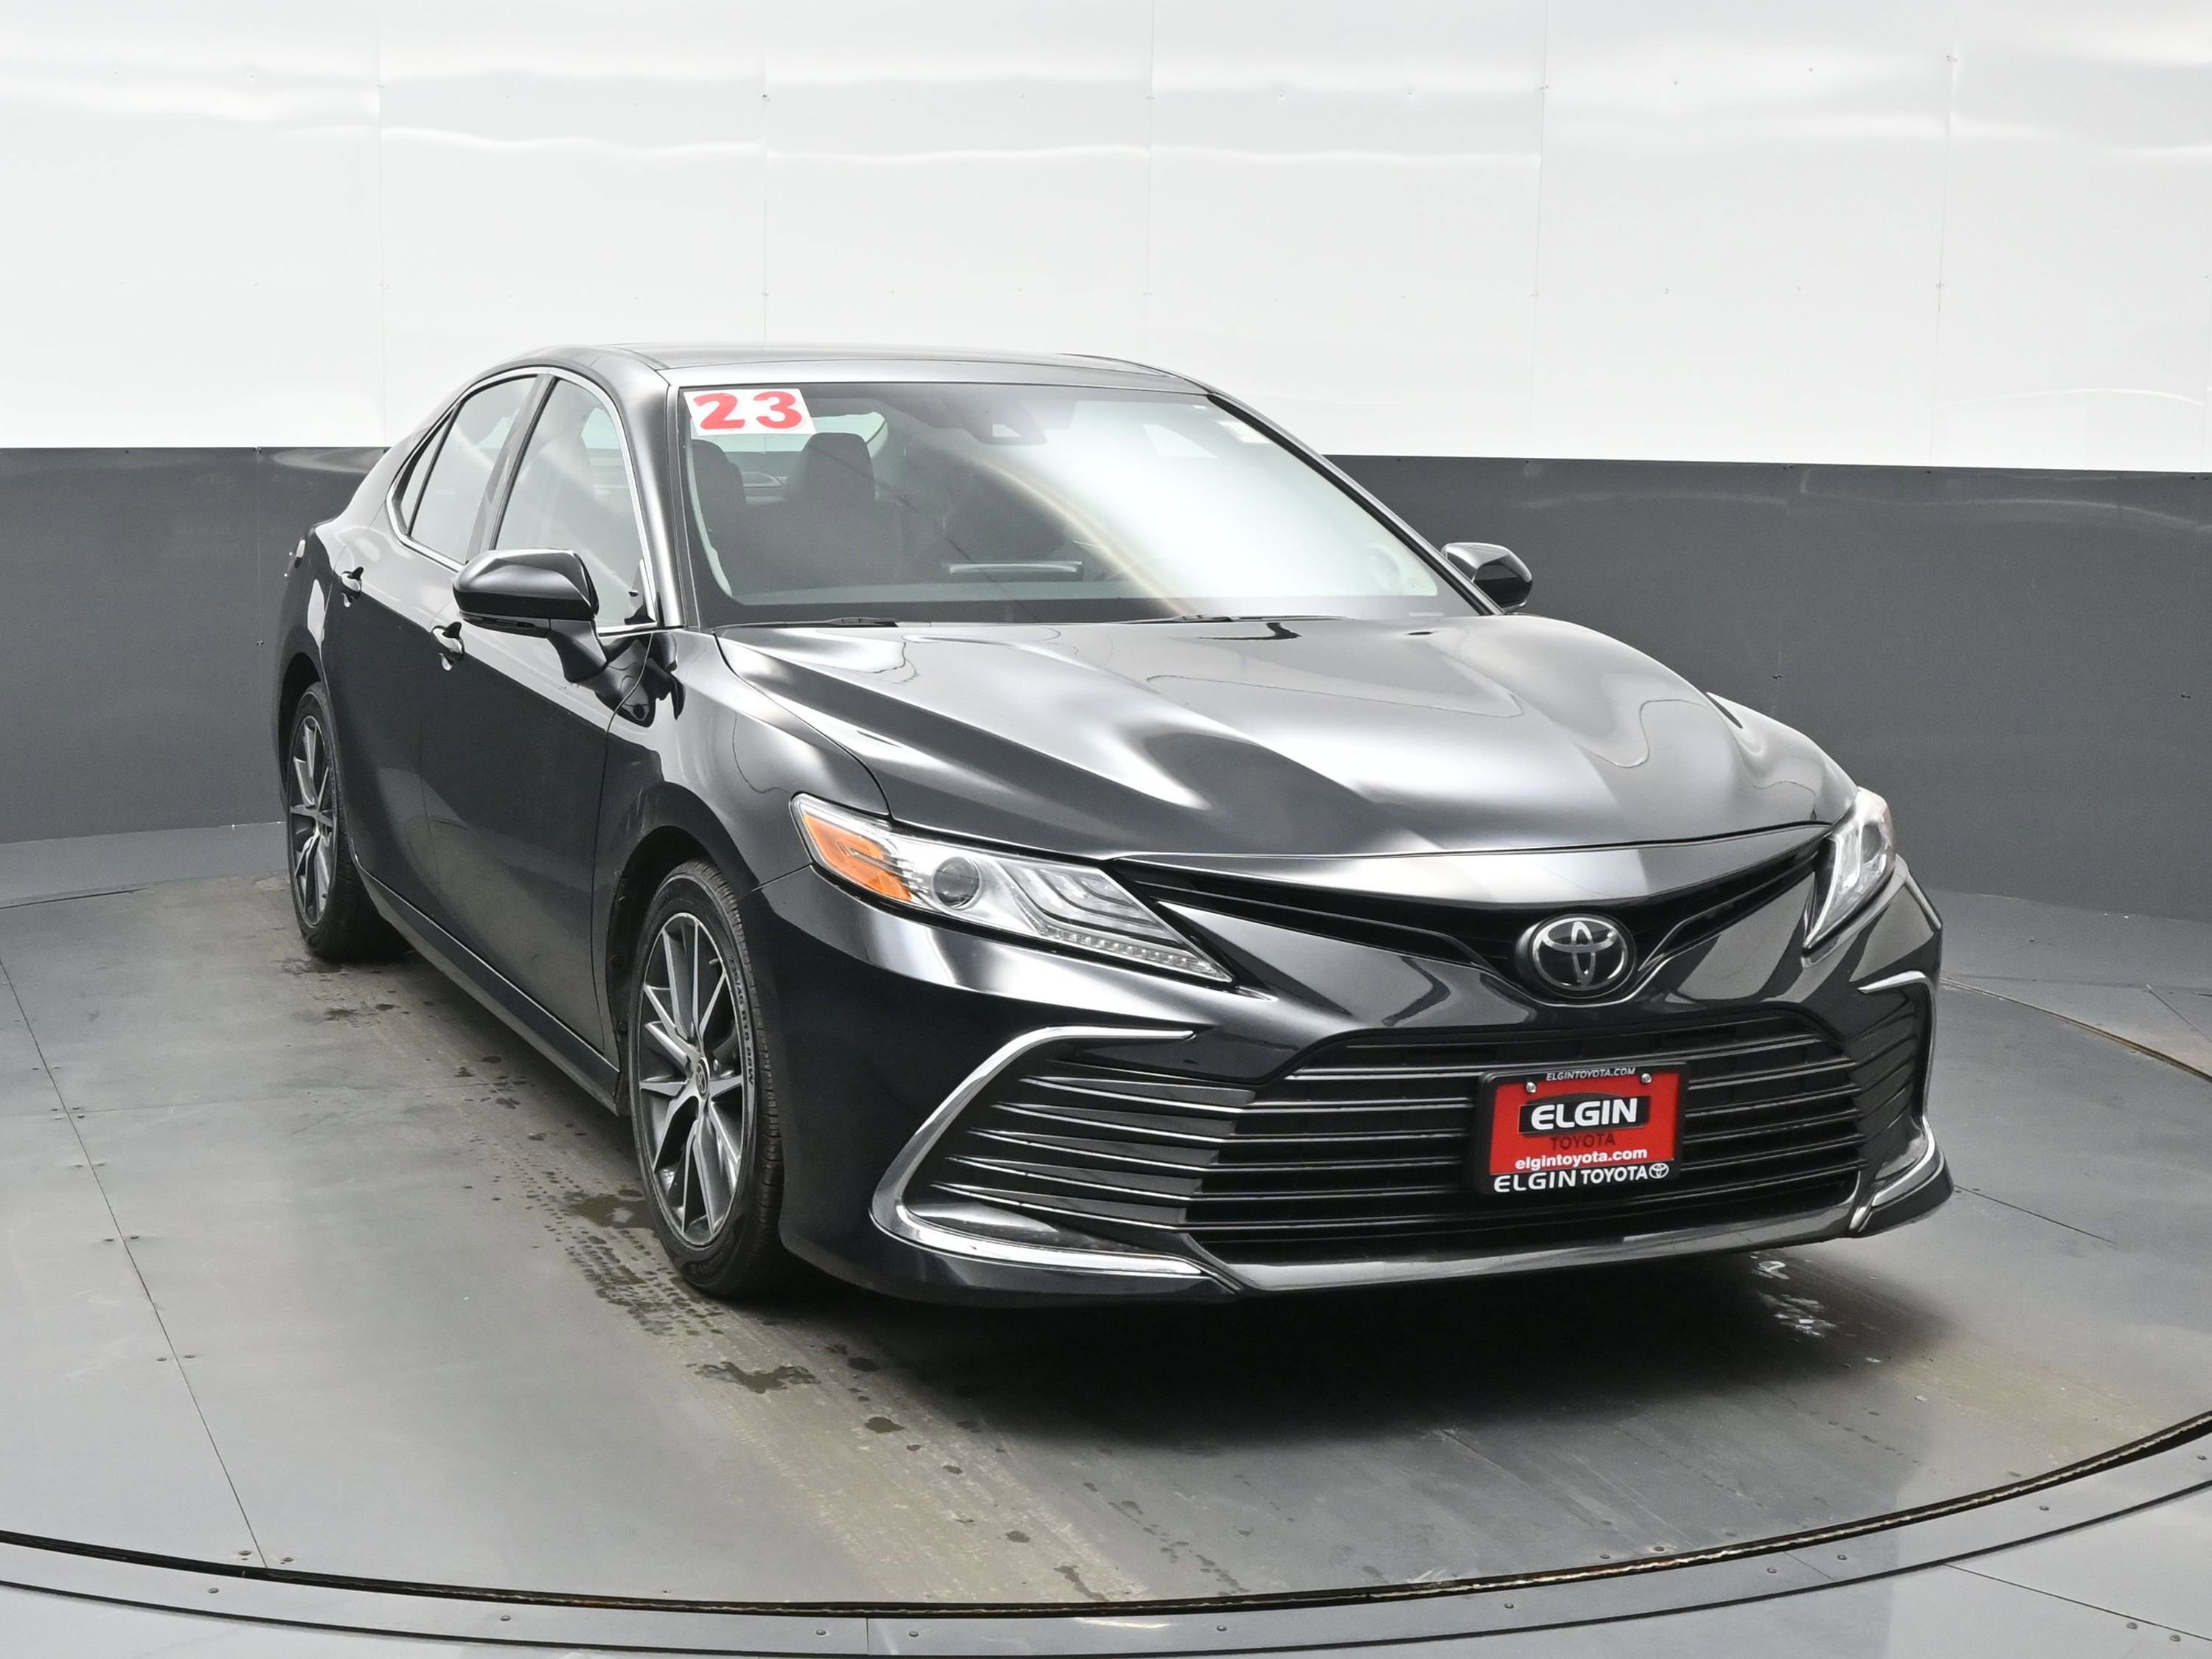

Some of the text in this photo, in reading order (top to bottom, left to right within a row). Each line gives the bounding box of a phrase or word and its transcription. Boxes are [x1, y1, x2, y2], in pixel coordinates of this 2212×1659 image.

[693, 391, 802, 430] 23
[1545, 1067, 1636, 1082] ELGINTOYOTA.COM
[1531, 1098, 1638, 1130] ELGIN
[1551, 1133, 1616, 1150] TOYOTA
[1514, 1148, 1648, 1171] elgintoyota.com
[1493, 1165, 1648, 1193] ELGIN TOYOTA
